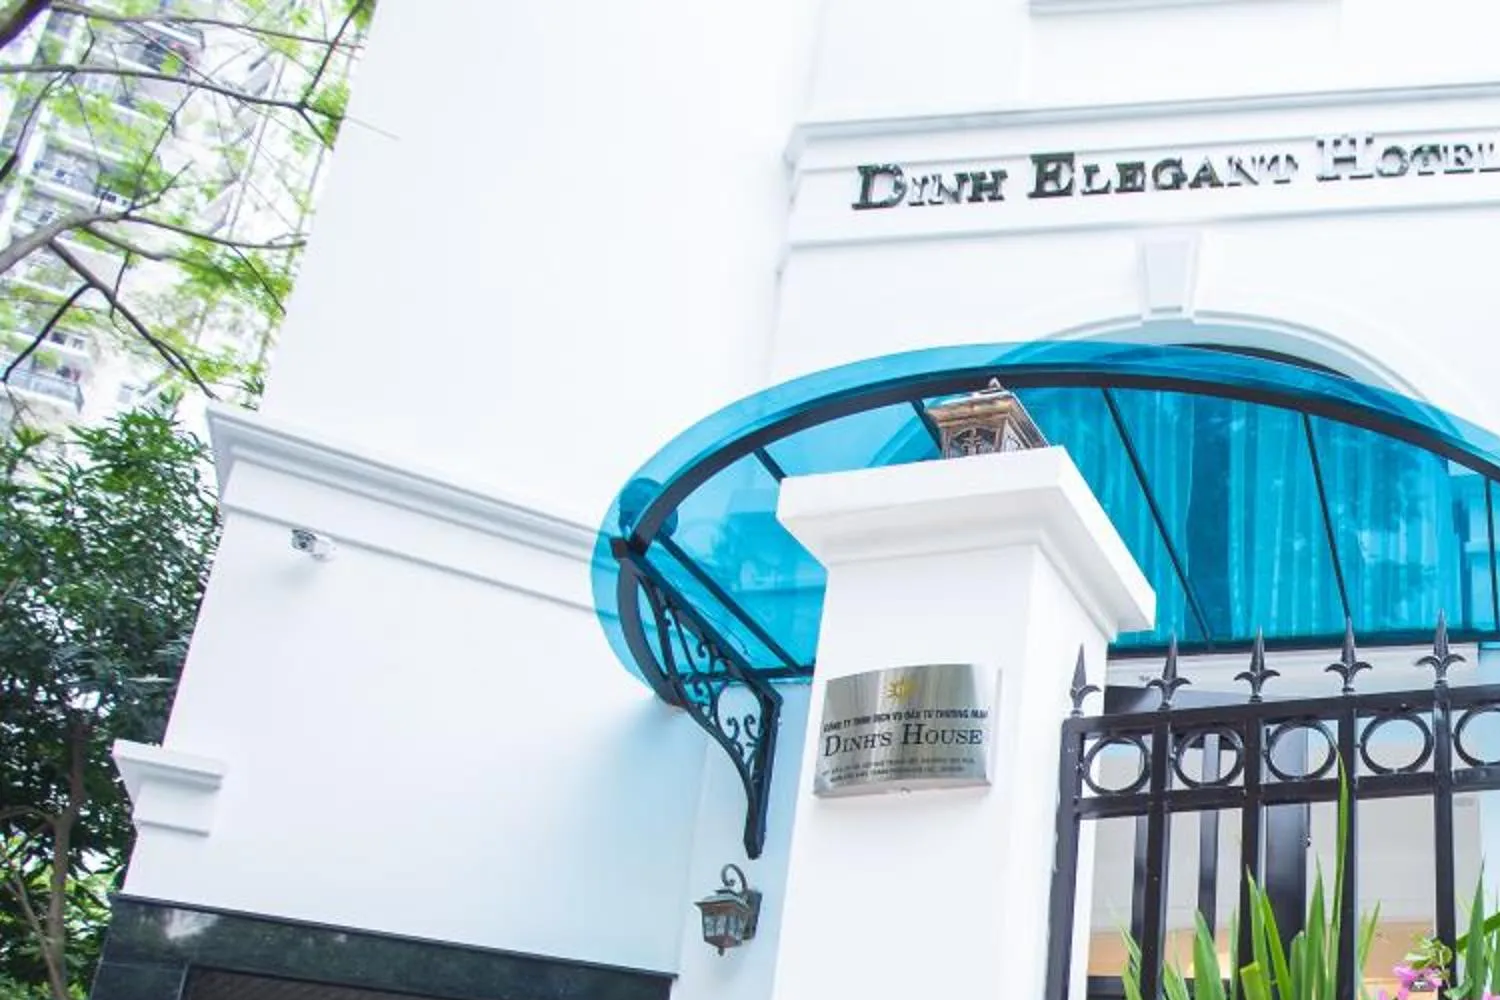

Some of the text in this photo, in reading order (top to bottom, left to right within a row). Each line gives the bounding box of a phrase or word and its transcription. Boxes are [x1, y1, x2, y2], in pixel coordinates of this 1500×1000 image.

[851, 162, 1008, 210] DINH
[1027, 151, 1299, 199] ELEGANT
[902, 723, 983, 745] HOUSE
